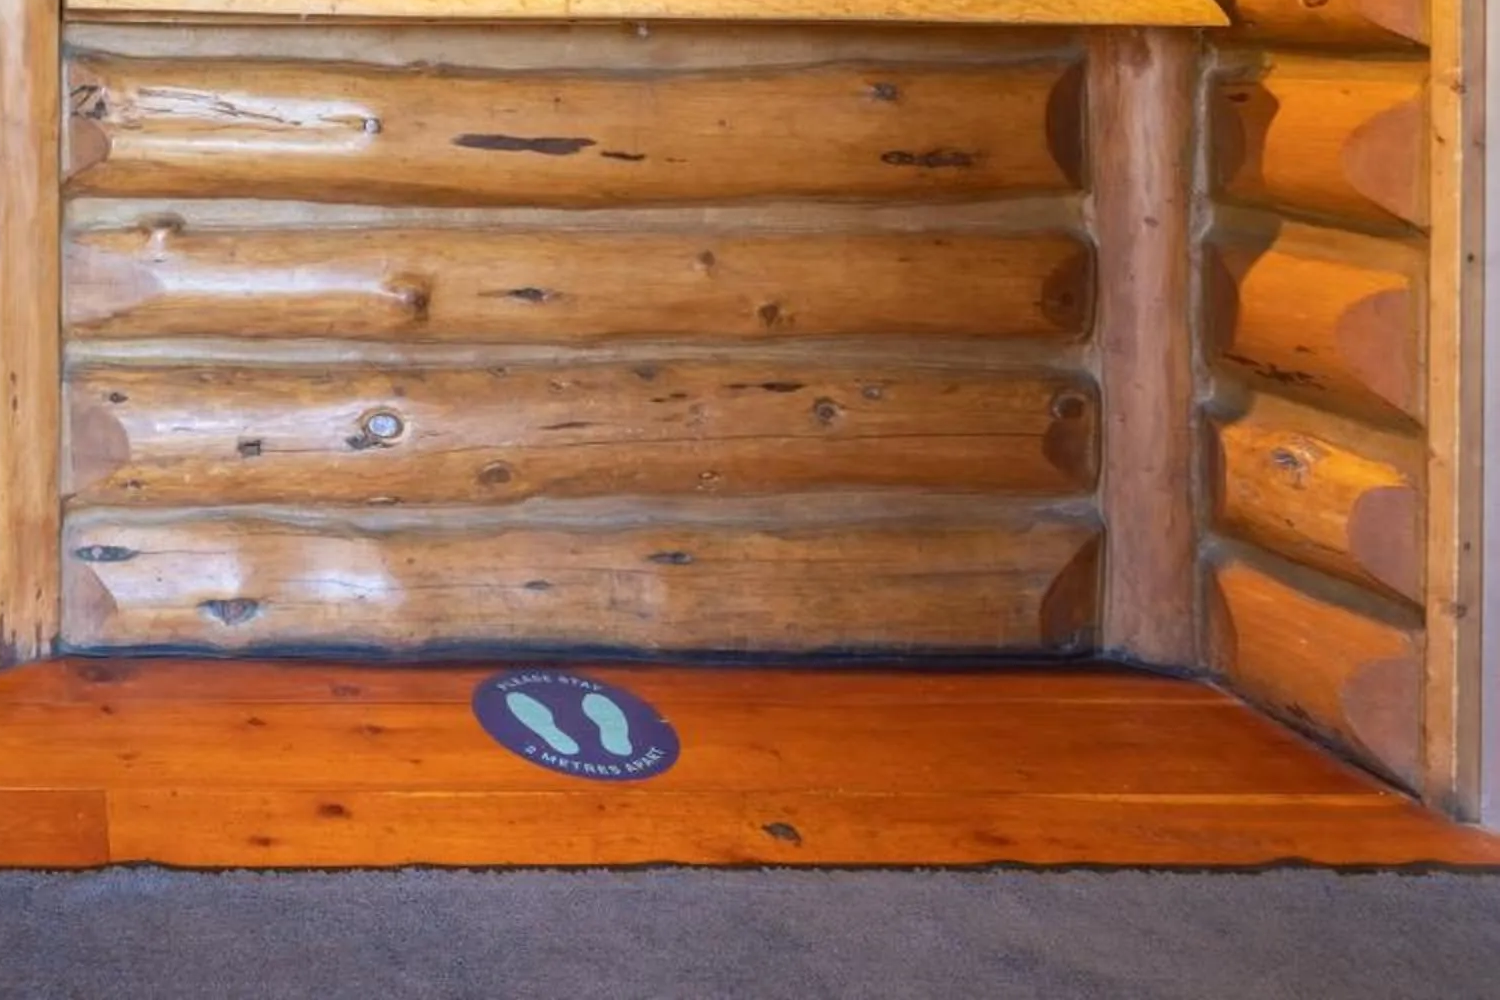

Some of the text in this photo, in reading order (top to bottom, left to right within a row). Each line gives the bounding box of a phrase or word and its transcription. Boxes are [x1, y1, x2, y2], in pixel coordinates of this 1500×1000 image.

[497, 673, 553, 692] PLEASE
[524, 744, 668, 776] 2 METRES APART
